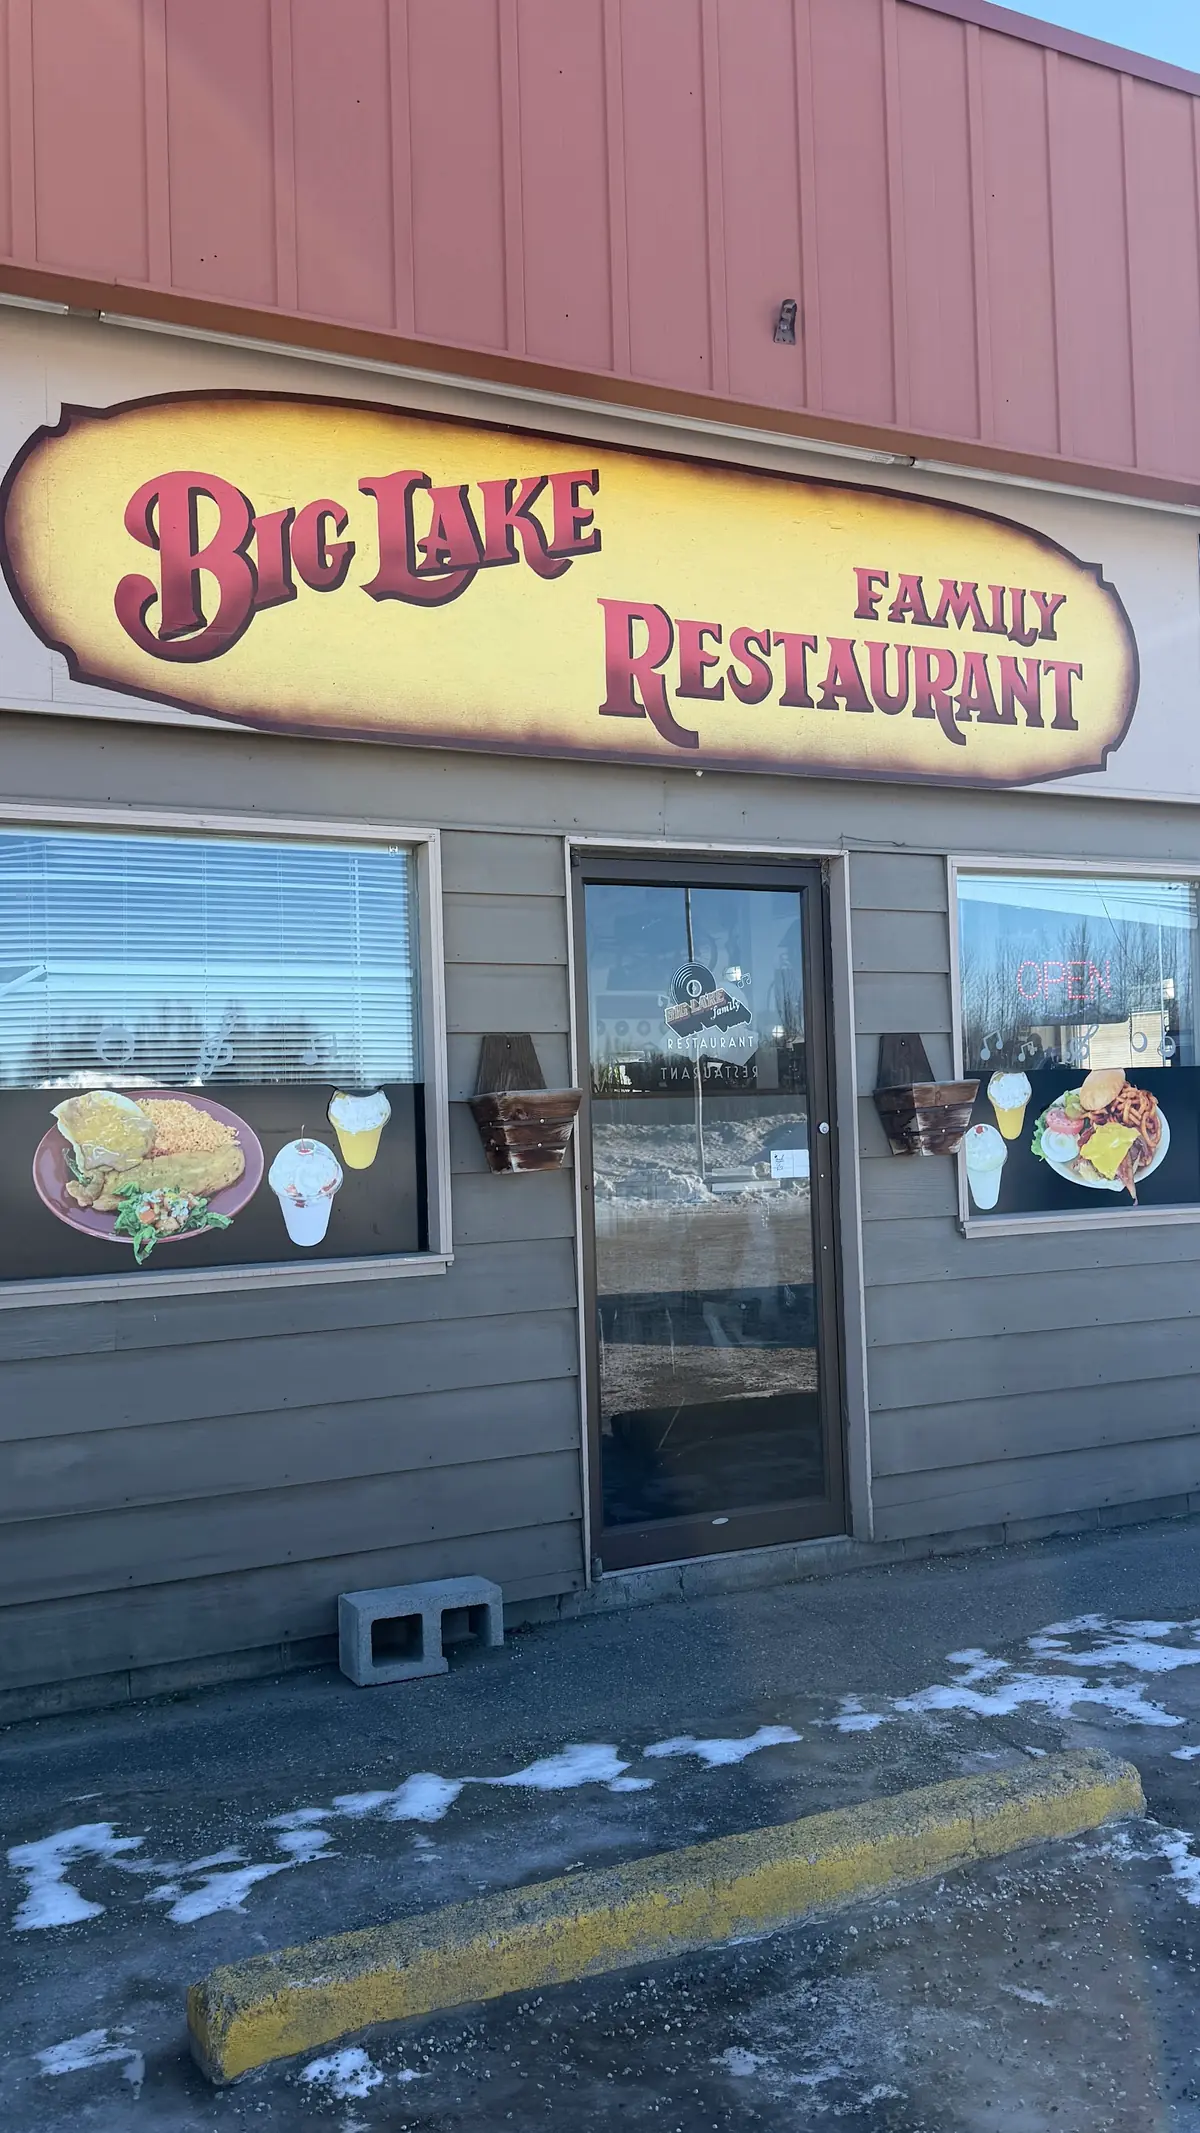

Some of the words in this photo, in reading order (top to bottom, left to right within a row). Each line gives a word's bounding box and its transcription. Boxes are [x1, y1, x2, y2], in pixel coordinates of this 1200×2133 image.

[114, 470, 355, 663] BIG
[358, 469, 602, 607] LAKE
[852, 567, 1067, 647] FAMILY
[597, 598, 1083, 749] RESTAURANT
[1017, 960, 1112, 1000] OPEN
[666, 1003, 690, 1023] BIG
[690, 990, 725, 1014] LAKE
[710, 998, 740, 1020] family
[667, 1036, 754, 1049] RESTAURANT
